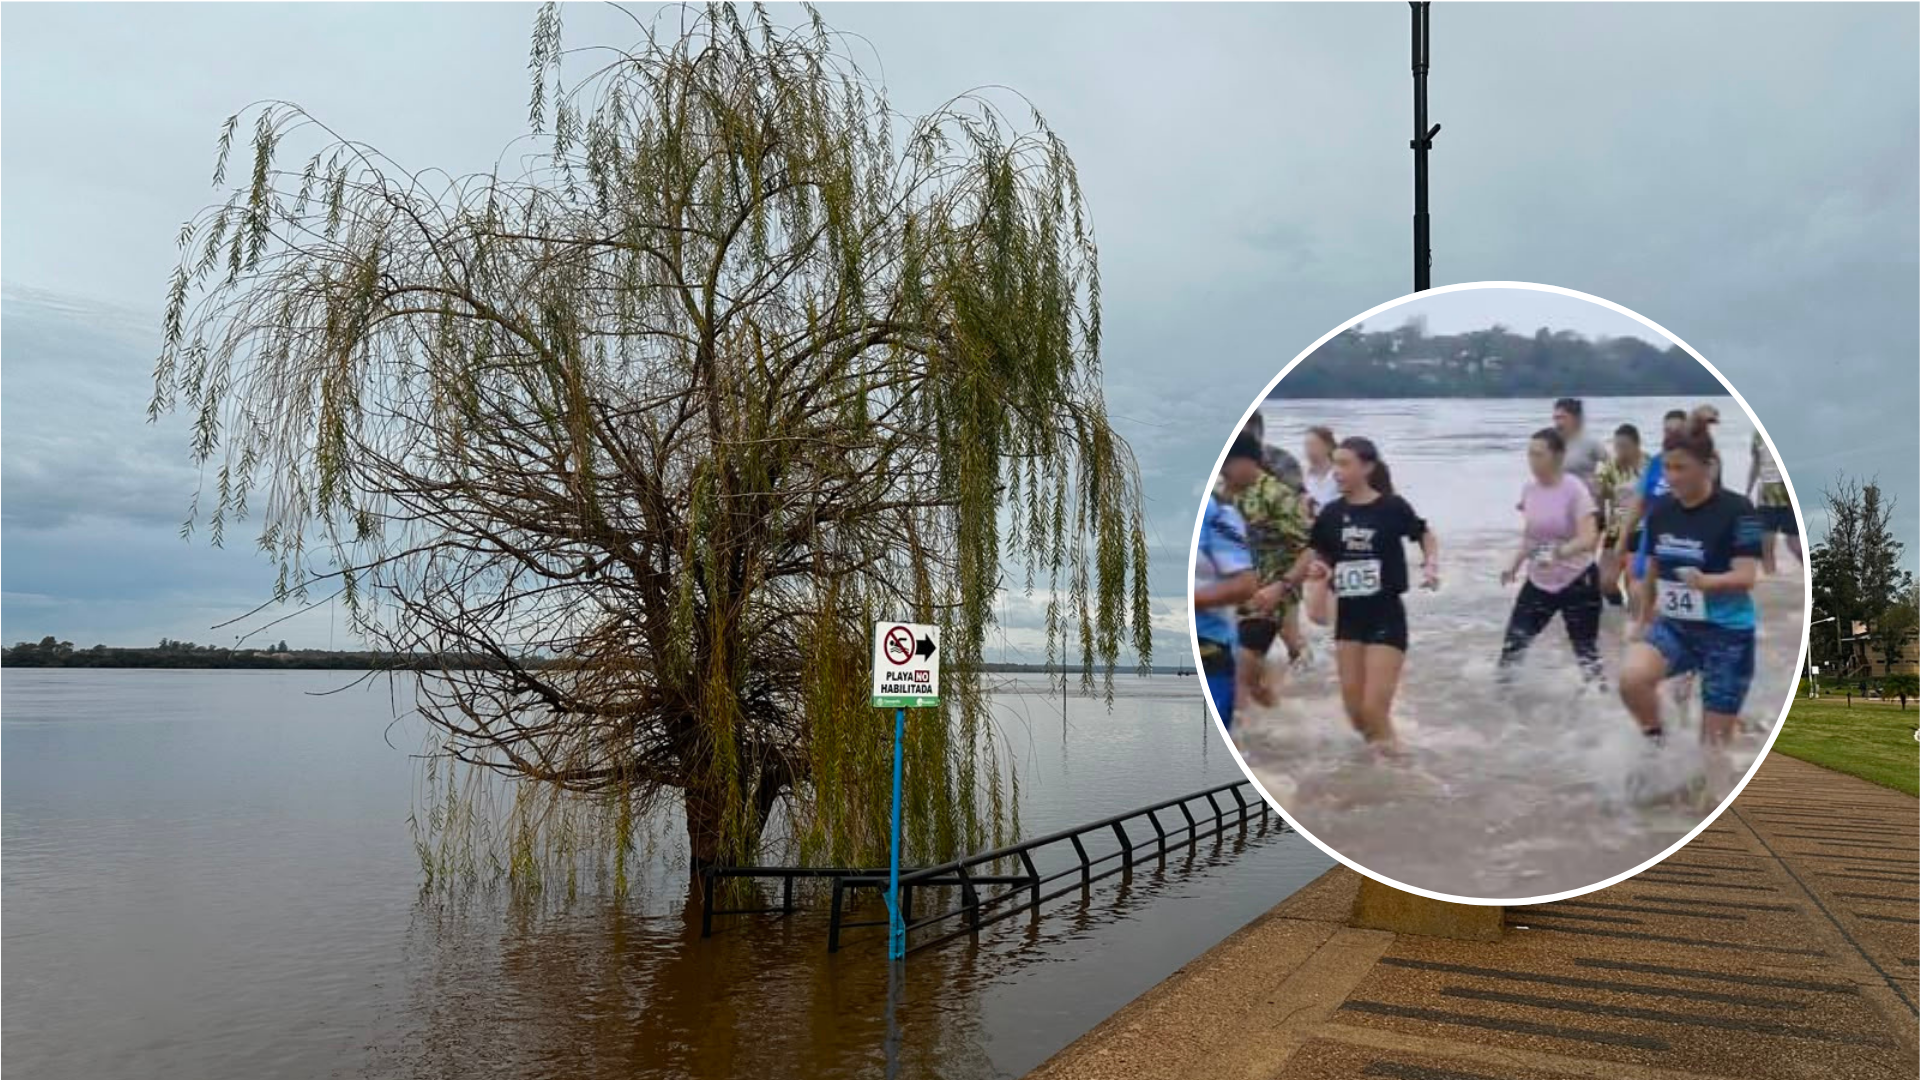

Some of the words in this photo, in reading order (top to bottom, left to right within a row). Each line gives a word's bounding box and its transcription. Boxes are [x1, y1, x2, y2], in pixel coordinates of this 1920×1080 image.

[1338, 570, 1377, 590] 105
[1665, 591, 1693, 612] 34
[886, 671, 913, 682] PLAYA
[915, 671, 929, 682] NO
[881, 684, 932, 694] HABILITADA
